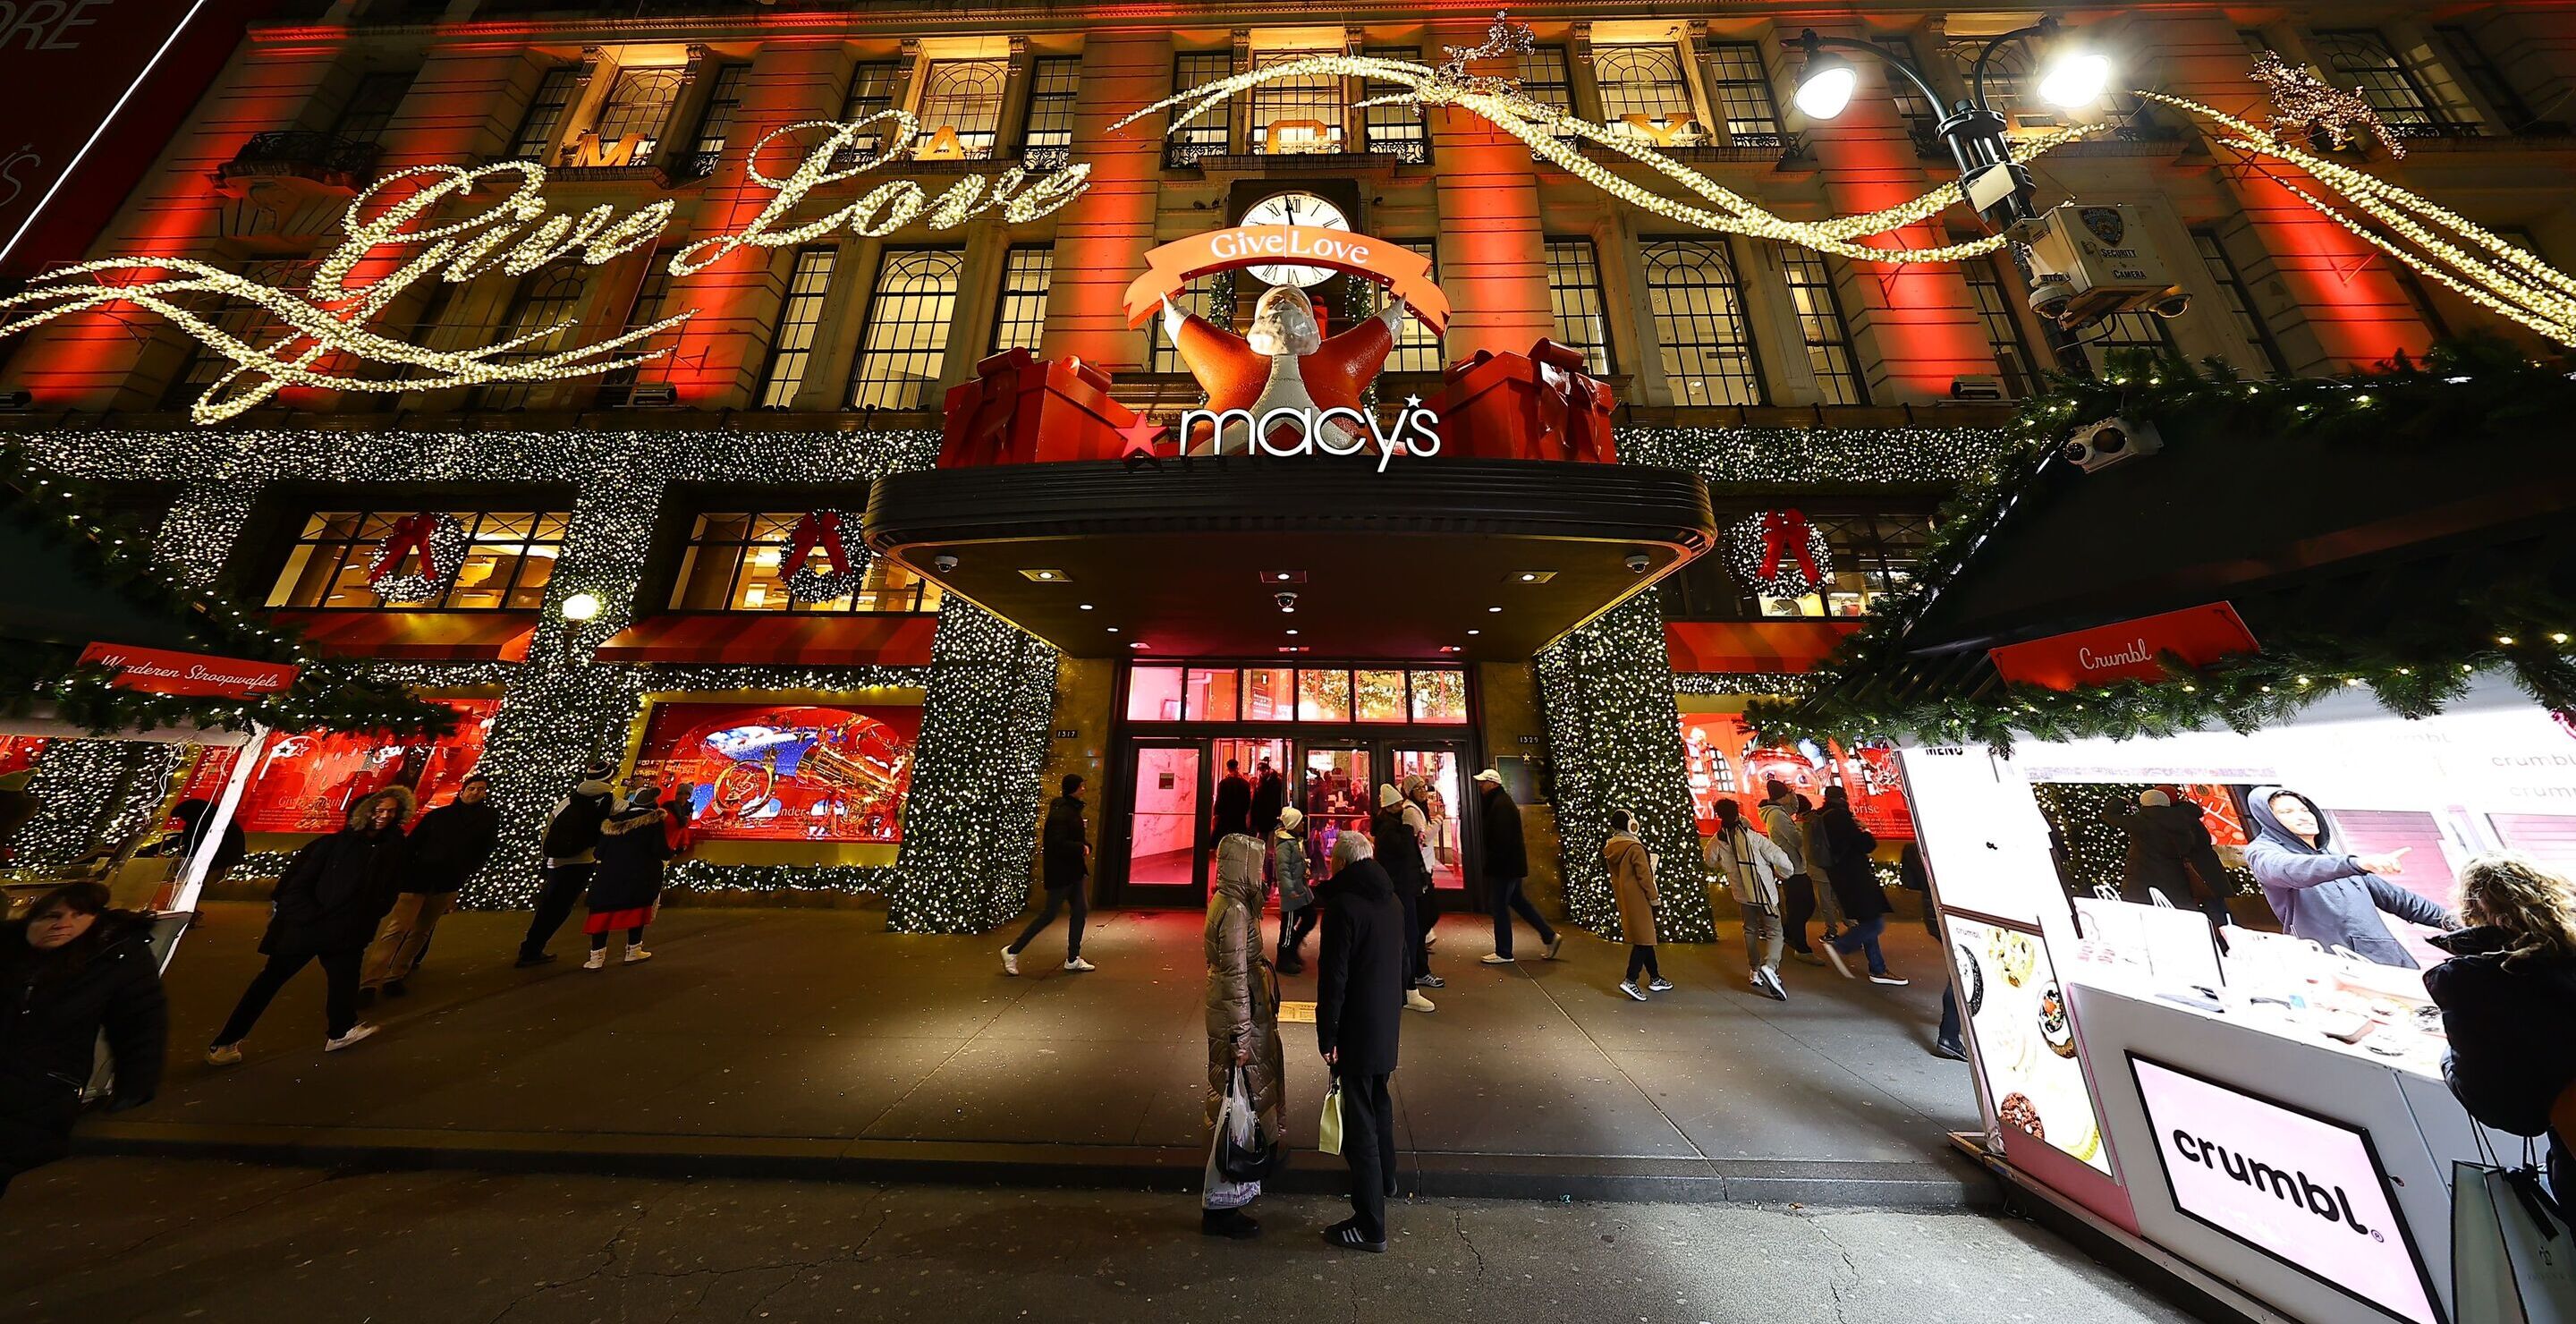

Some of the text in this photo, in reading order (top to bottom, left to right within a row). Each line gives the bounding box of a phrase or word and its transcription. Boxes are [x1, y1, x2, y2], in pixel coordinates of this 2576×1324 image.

[668, 108, 1091, 276] Love
[1210, 230, 1370, 265] Give Love
[2101, 248, 2138, 258] SECURITY
[2113, 269, 2147, 279] CAMERA
[2080, 638, 2152, 669] Crumbl
[101, 654, 279, 690] Wnderen Stroopwafels
[2174, 1129, 2368, 1235] crumbl
